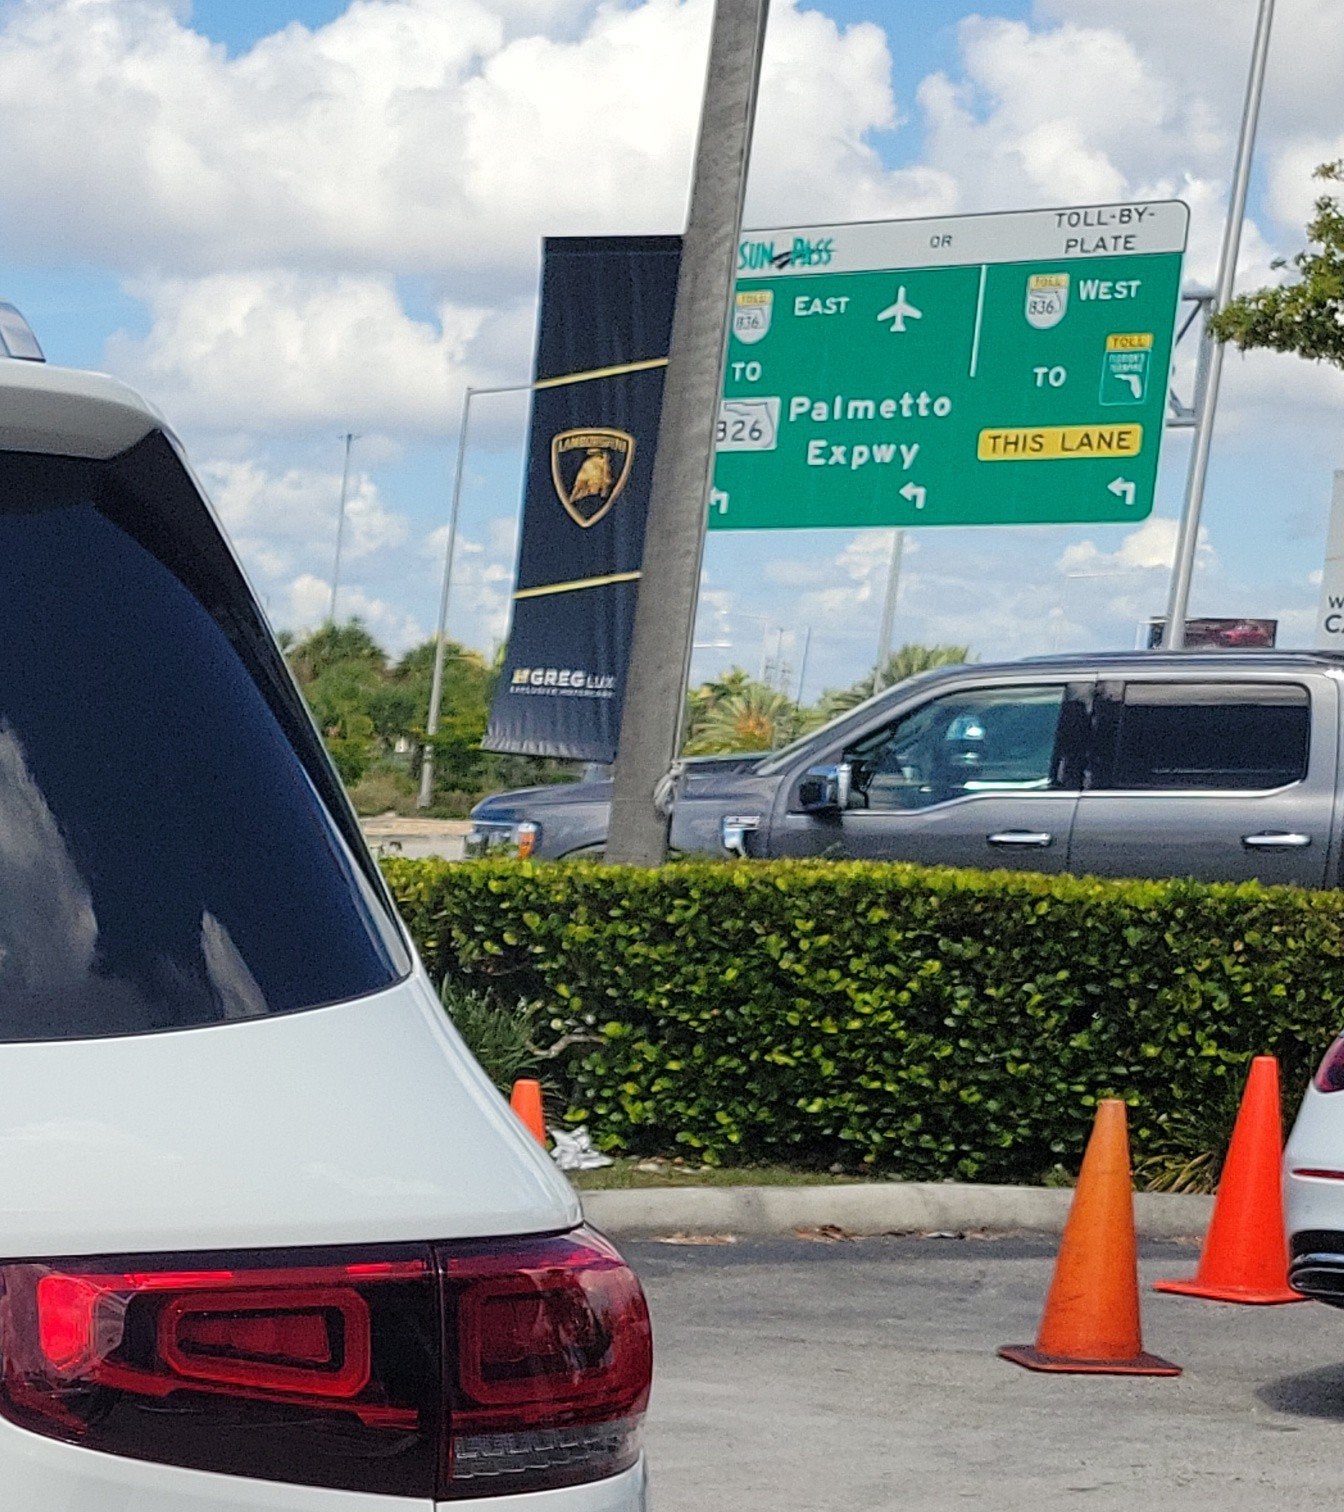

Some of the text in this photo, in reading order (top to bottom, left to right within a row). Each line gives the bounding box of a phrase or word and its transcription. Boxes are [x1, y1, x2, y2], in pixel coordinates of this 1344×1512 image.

[930, 235, 952, 249] OR
[1065, 235, 1136, 253] PLATE
[1079, 279, 1141, 300] WEST
[794, 296, 850, 316] EAST
[732, 361, 762, 382] TO
[1033, 366, 1067, 388] TO
[789, 391, 952, 422] Palmetto
[989, 431, 1132, 454] THIS LANE
[807, 439, 920, 470] Expwy
[1325, 615, 1344, 633] C
